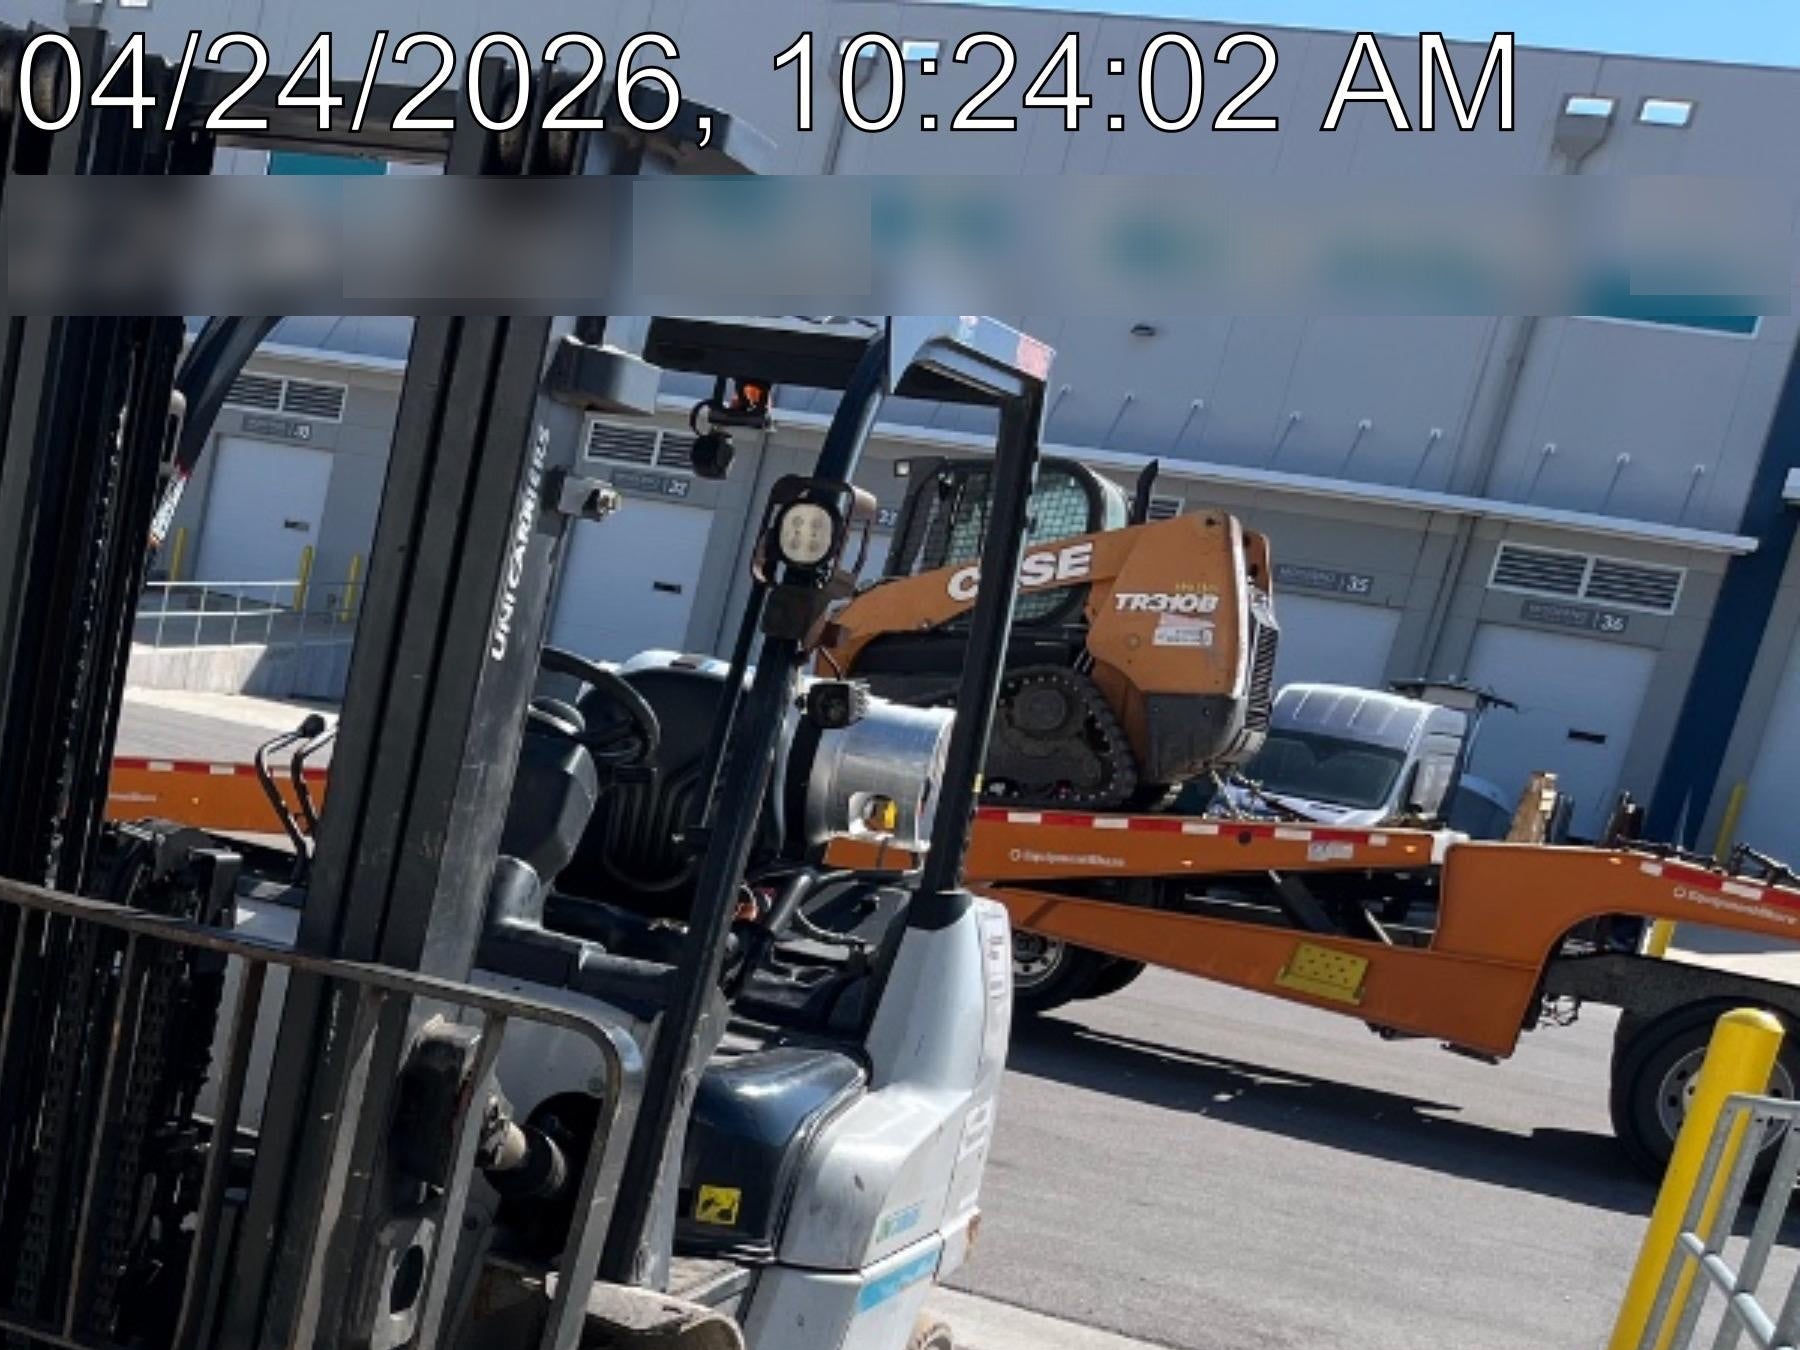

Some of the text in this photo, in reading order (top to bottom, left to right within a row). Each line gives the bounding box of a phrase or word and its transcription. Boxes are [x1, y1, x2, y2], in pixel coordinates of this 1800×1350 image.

[491, 425, 550, 661] UNICARRIERS
[948, 542, 1093, 600] CSE
[1347, 575, 1369, 592] 35
[1115, 592, 1219, 614] TR310B
[1601, 614, 1624, 631] 36
